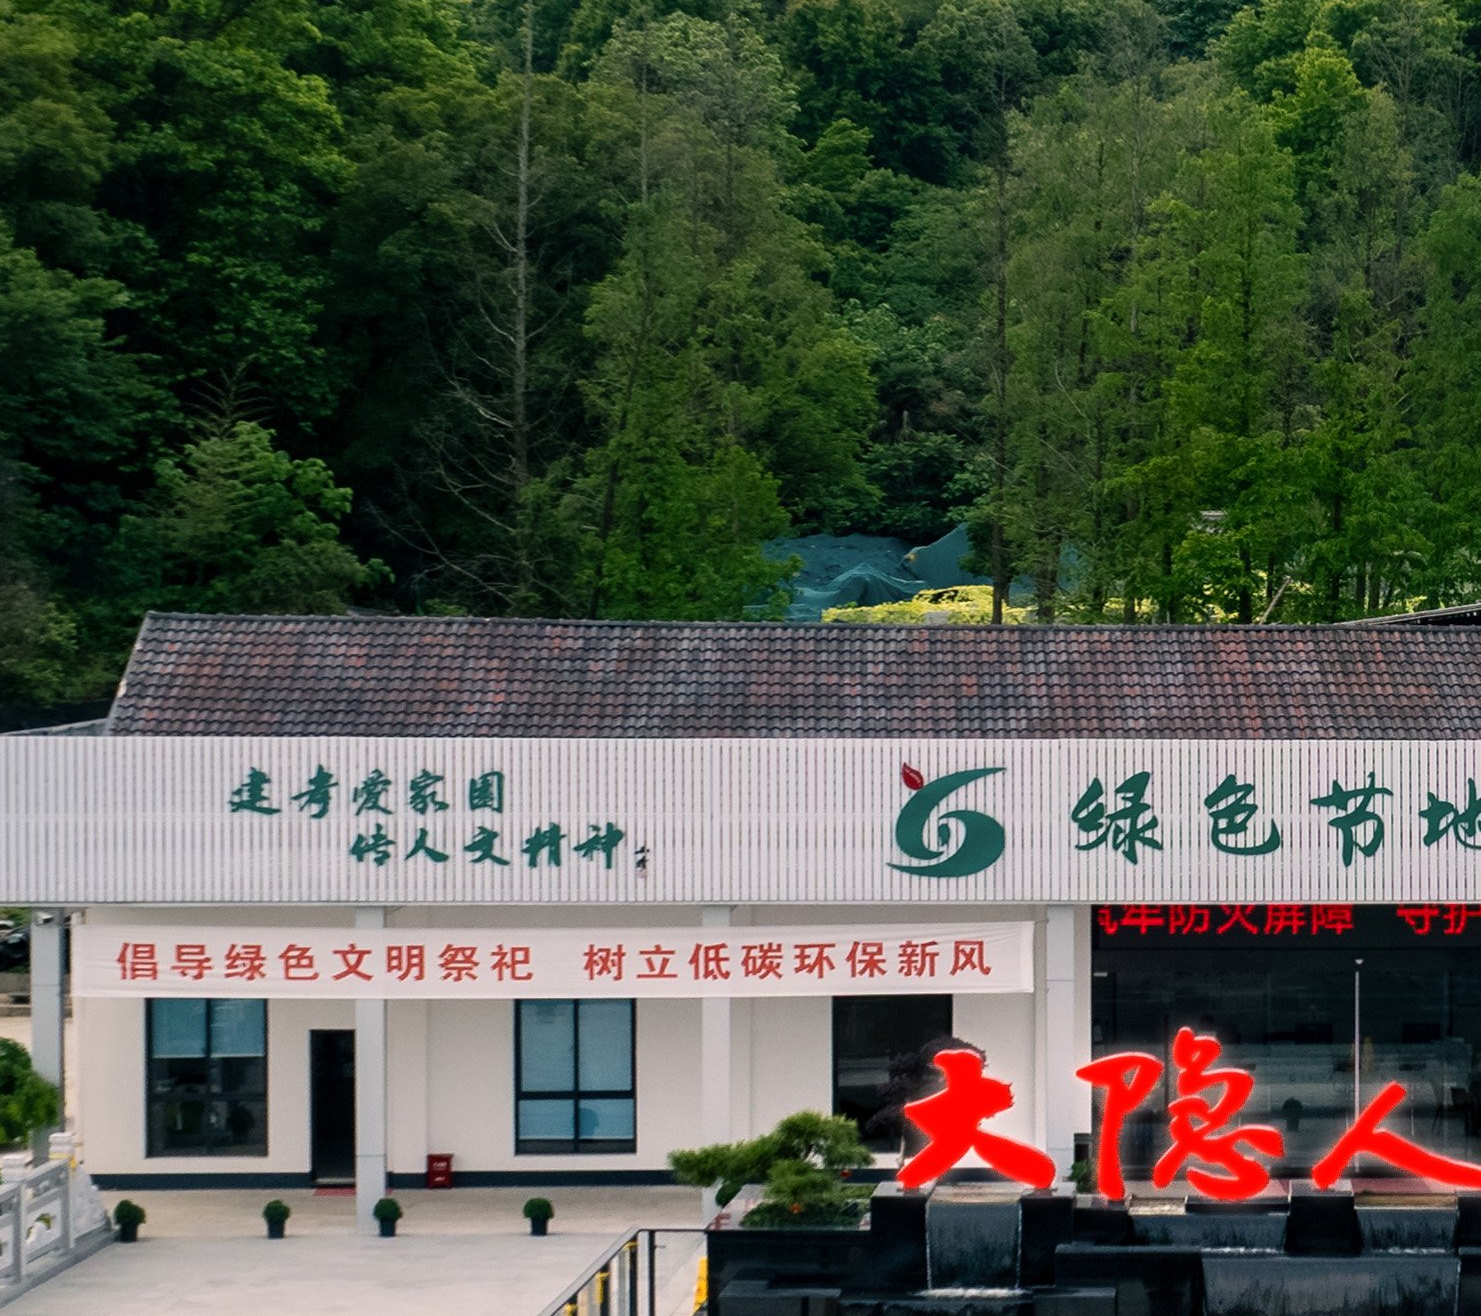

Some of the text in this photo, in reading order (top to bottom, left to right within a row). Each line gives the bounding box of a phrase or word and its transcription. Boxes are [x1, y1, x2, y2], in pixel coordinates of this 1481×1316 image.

[117, 939, 993, 983] 倡导绿色文明祭祀 树立低碳环保新风
